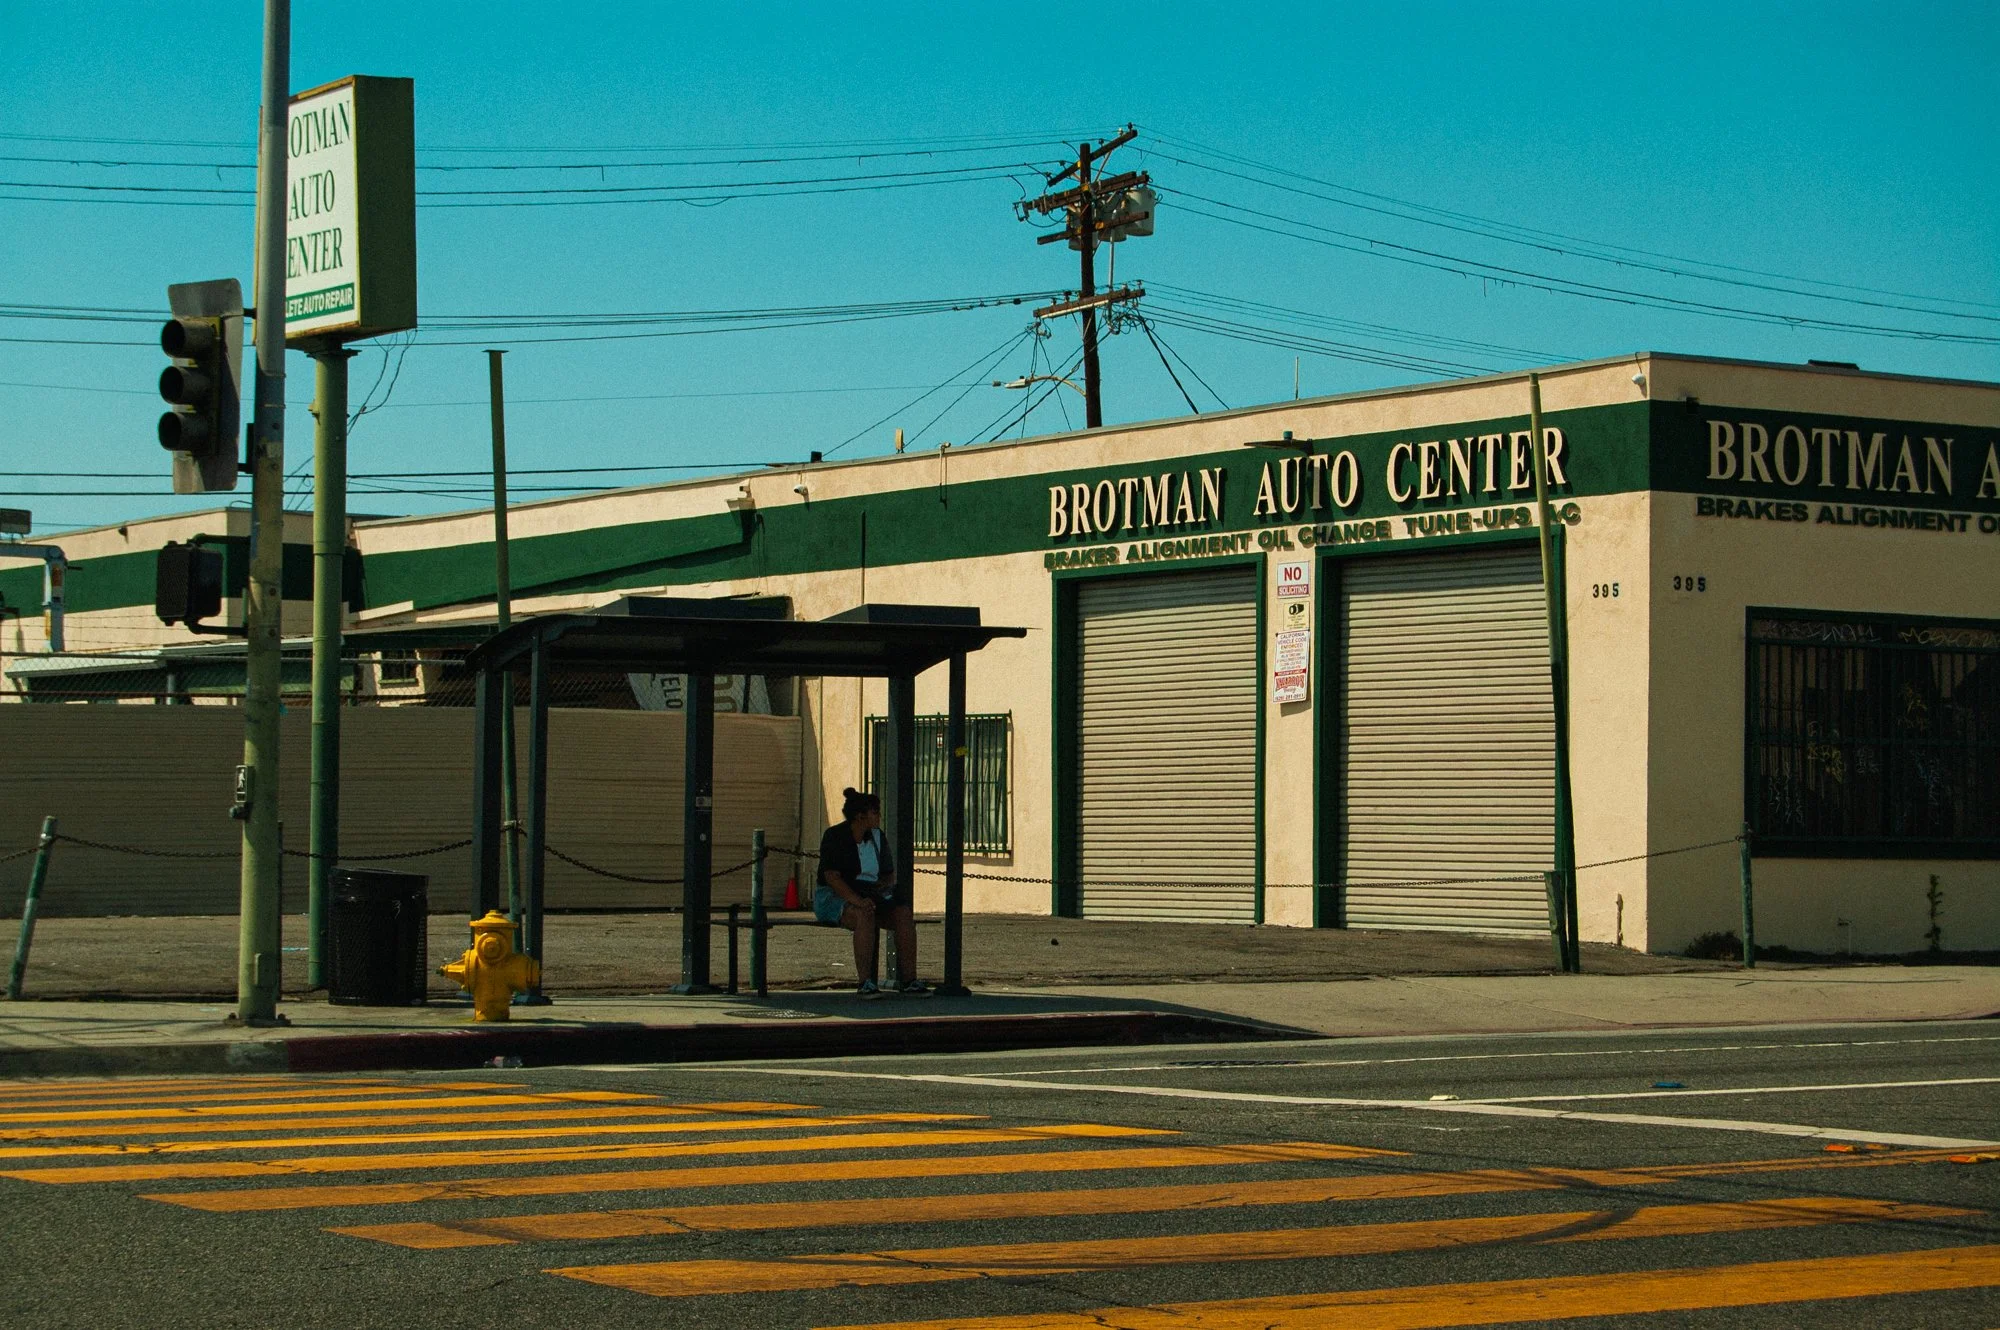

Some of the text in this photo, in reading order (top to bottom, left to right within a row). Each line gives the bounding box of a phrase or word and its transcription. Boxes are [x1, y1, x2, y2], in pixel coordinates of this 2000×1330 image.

[287, 100, 351, 160] OTMAN
[288, 169, 335, 221] AUTO
[287, 227, 343, 280] ENTER
[285, 287, 353, 318] LETE AUTO REPAIR
[1706, 420, 1954, 496] BROTMAN
[1048, 426, 1568, 538] BROTMAN AUTO CENTER
[1696, 496, 1809, 523] BRAKES
[1816, 505, 1972, 534] ALIGNMENT
[1044, 545, 1119, 570] BRAKES
[1127, 532, 1253, 562] ALIGNMENT
[1257, 528, 1294, 551] OIL
[1298, 520, 1390, 547] CHANGE
[1403, 506, 1532, 538] TUNE-UPS
[1278, 585, 1308, 595] SOLICITING
[1284, 567, 1302, 581] NO
[1592, 582, 1620, 598] 395
[1673, 575, 1706, 592] 395
